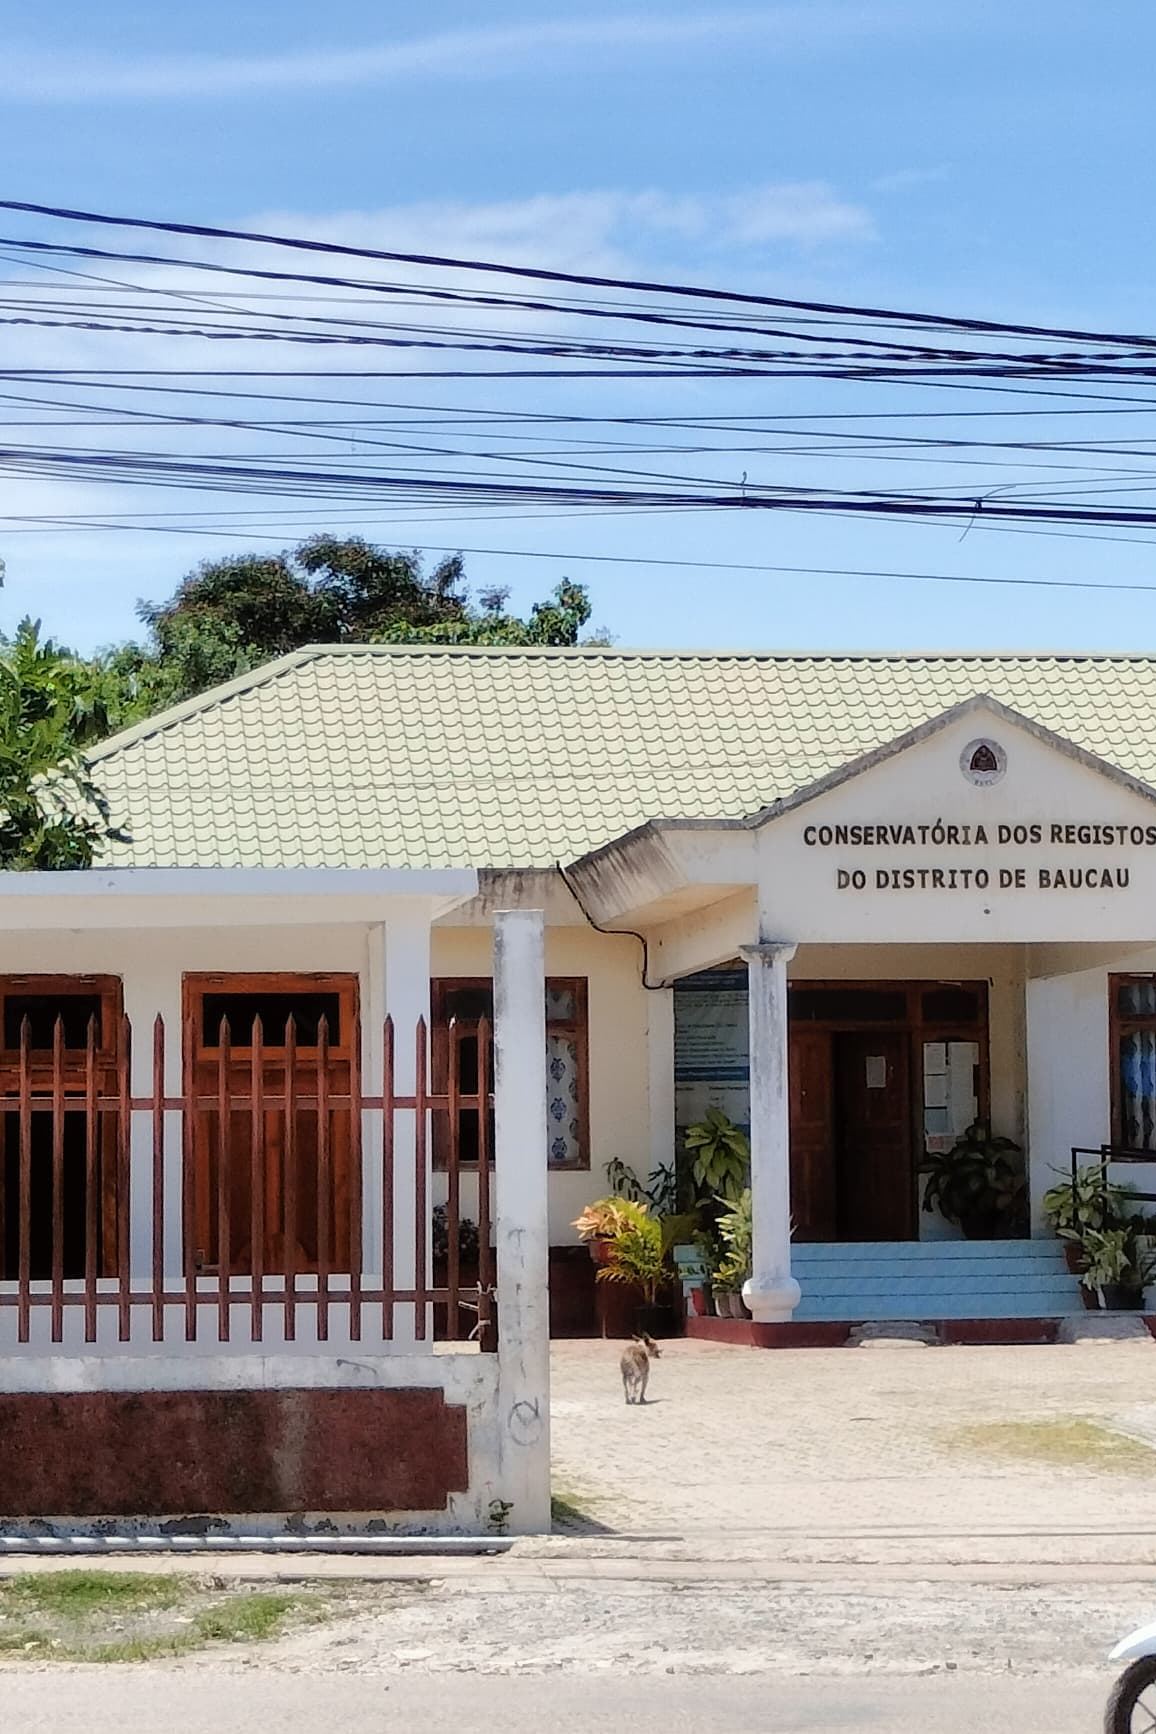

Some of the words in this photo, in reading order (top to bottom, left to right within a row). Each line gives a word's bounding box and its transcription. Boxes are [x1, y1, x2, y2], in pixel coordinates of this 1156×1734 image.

[803, 817, 989, 846] CONSERVATÓRIA
[997, 824, 1043, 845] DOS
[836, 868, 867, 890] DO
[875, 868, 990, 890] DISTRITO
[999, 868, 1027, 889] DE
[1038, 867, 1131, 889] BAUCAU
